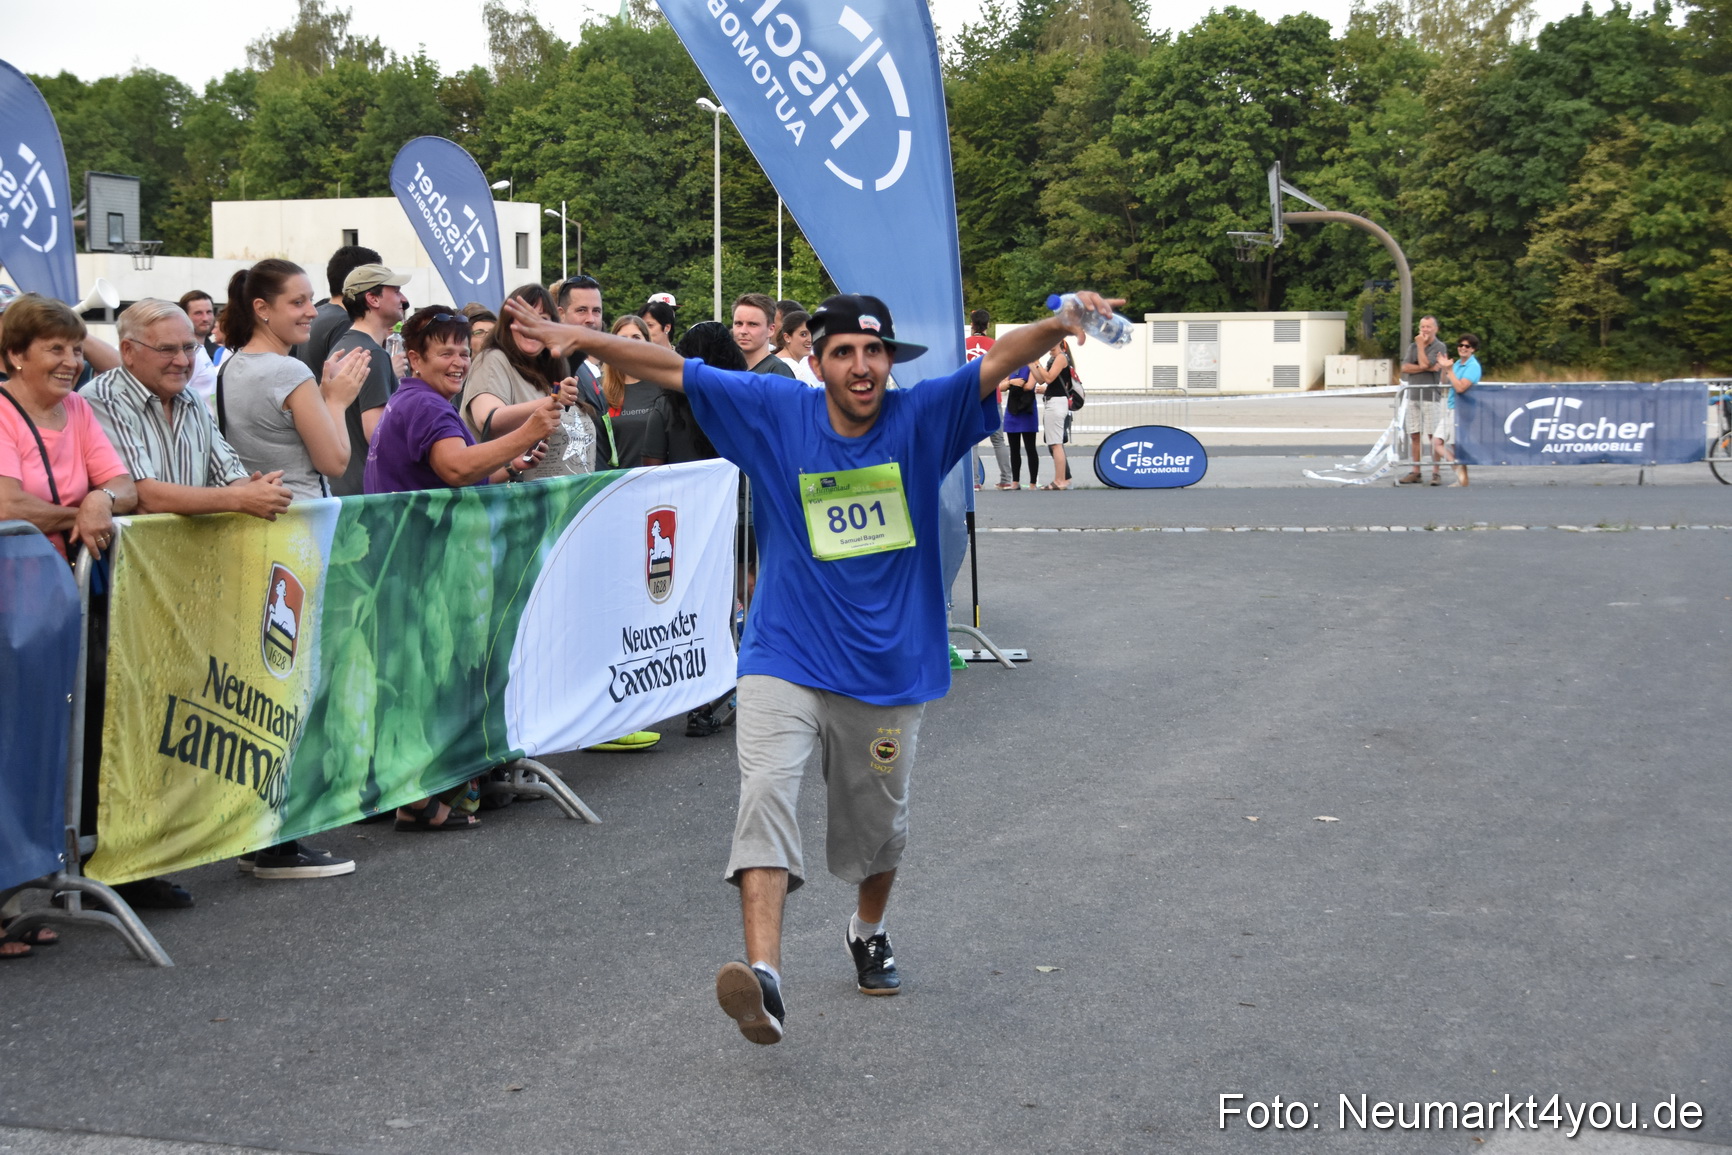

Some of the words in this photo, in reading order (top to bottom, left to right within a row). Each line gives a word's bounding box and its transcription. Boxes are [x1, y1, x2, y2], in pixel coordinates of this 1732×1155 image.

[1530, 416, 1655, 440] Fischer
[1541, 442, 1644, 453] AUTOMOBILE
[1126, 452, 1194, 467] Fischer
[1133, 466, 1190, 474] AUTOMOBILE
[827, 500, 886, 533] 801
[839, 536, 863, 545] Samuel
[863, 533, 885, 543] Bagam
[653, 579, 667, 594] 1628
[268, 646, 286, 671] 1628
